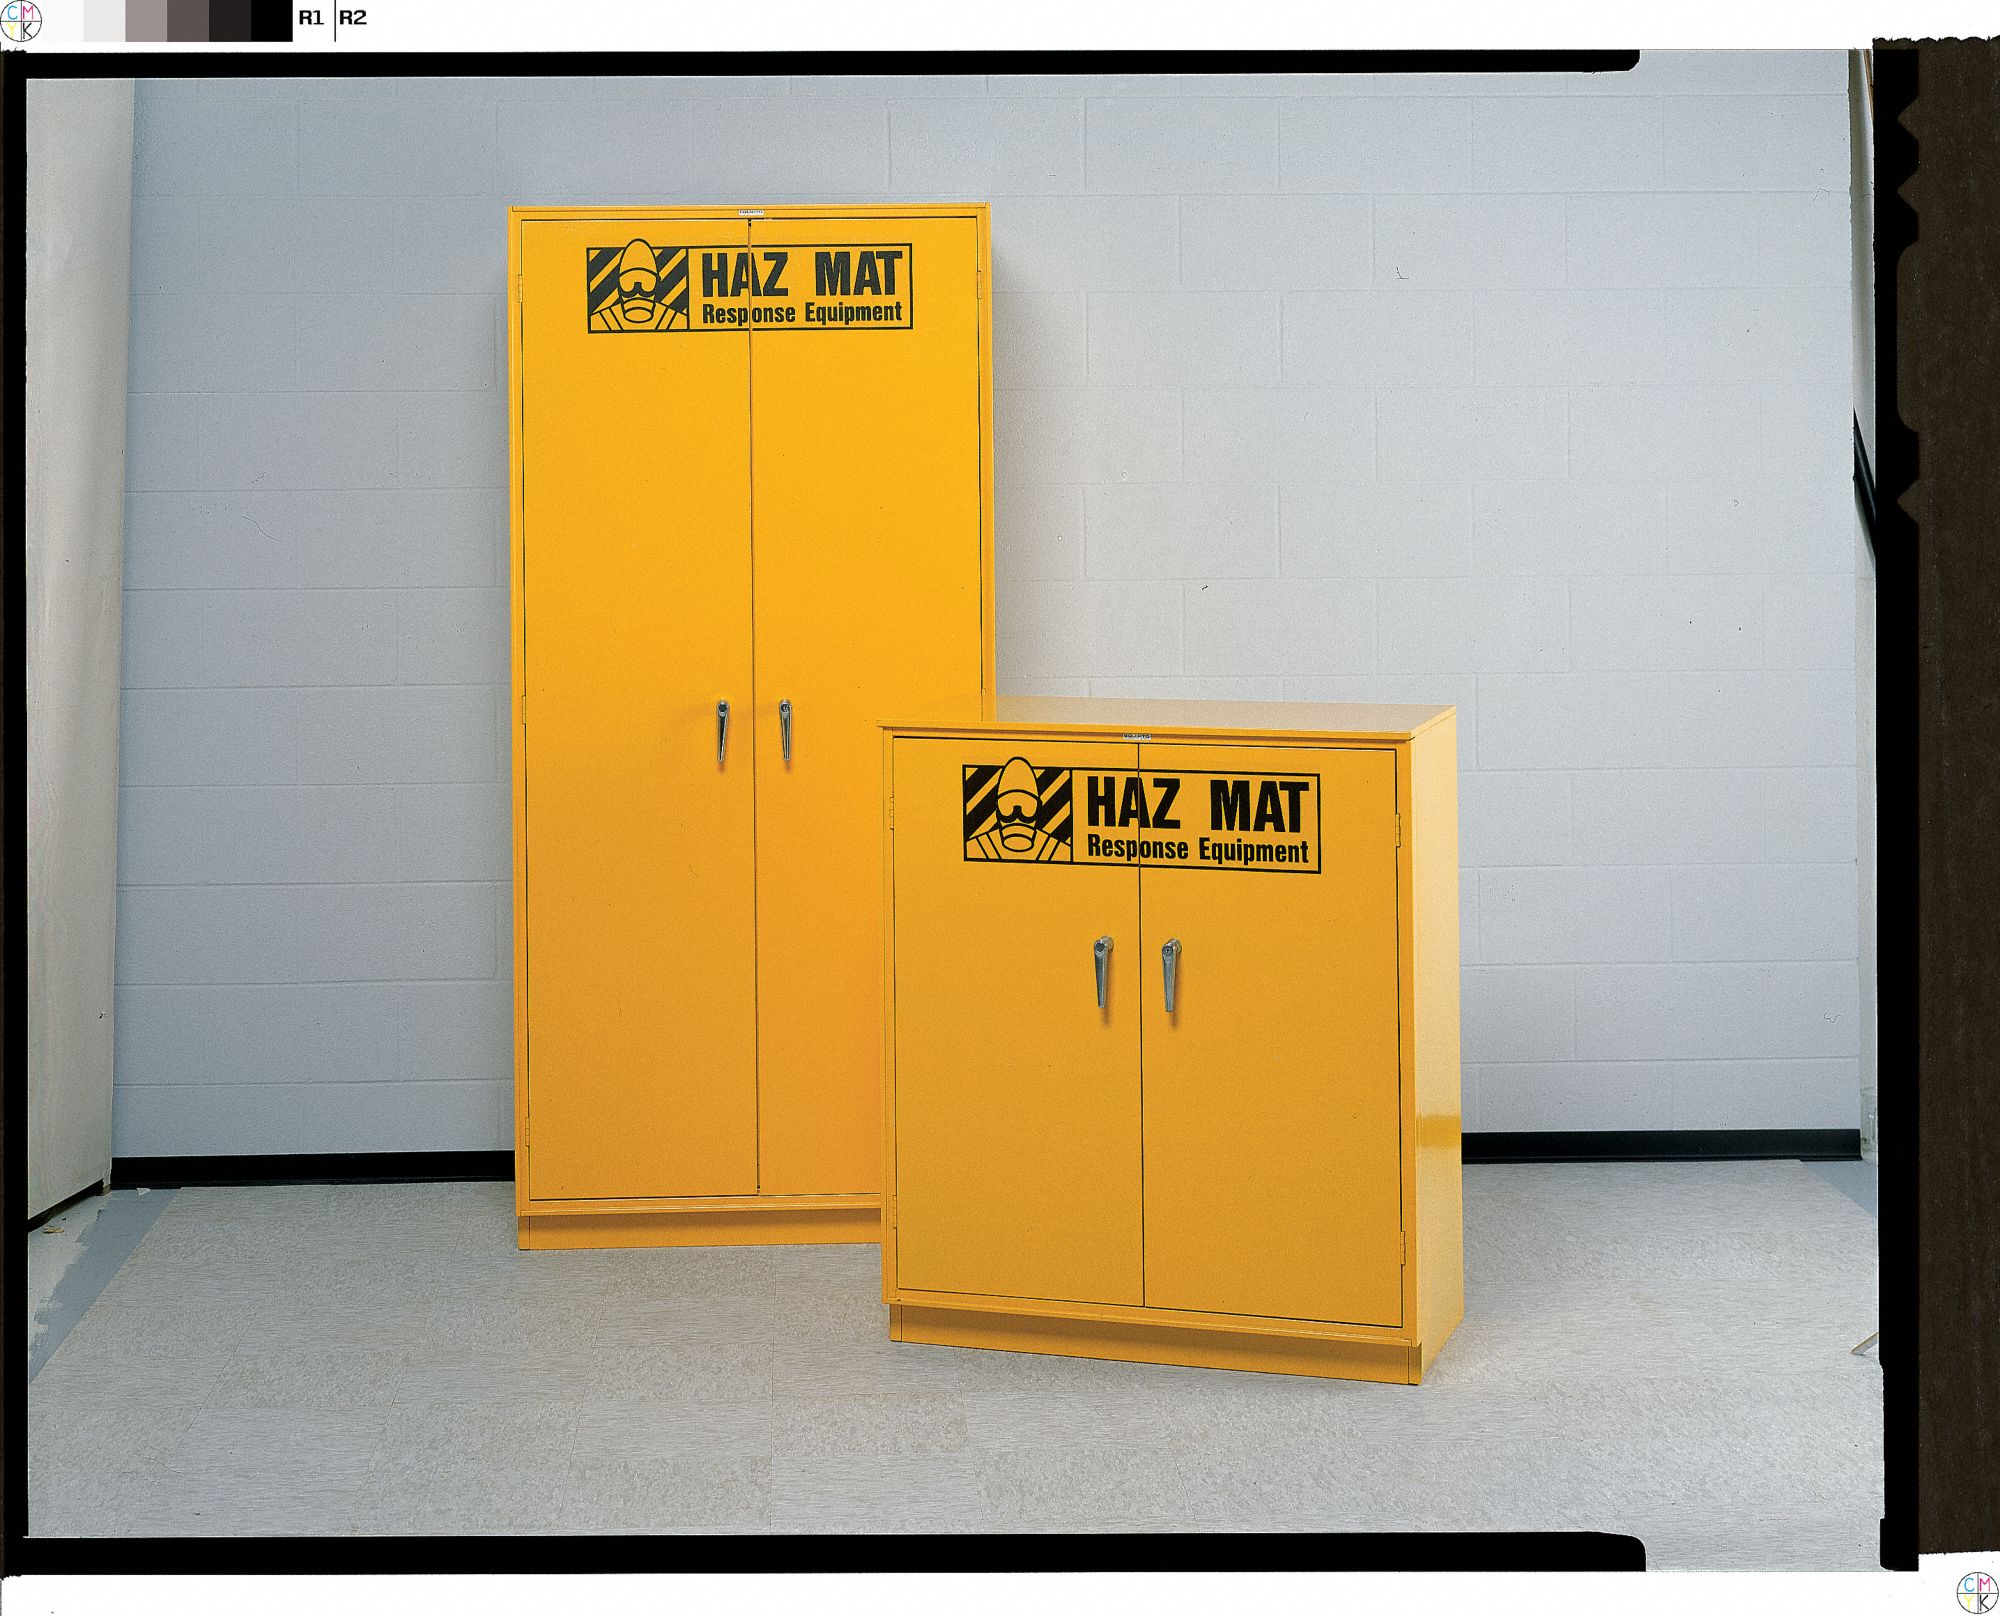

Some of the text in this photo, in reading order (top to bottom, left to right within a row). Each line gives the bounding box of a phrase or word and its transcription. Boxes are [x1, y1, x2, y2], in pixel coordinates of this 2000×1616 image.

[702, 250, 903, 297] HAZ MAT
[702, 302, 903, 325] Response Equipment
[1087, 775, 1310, 833] HAZ MAT
[1087, 833, 1309, 866] Response Equipment
